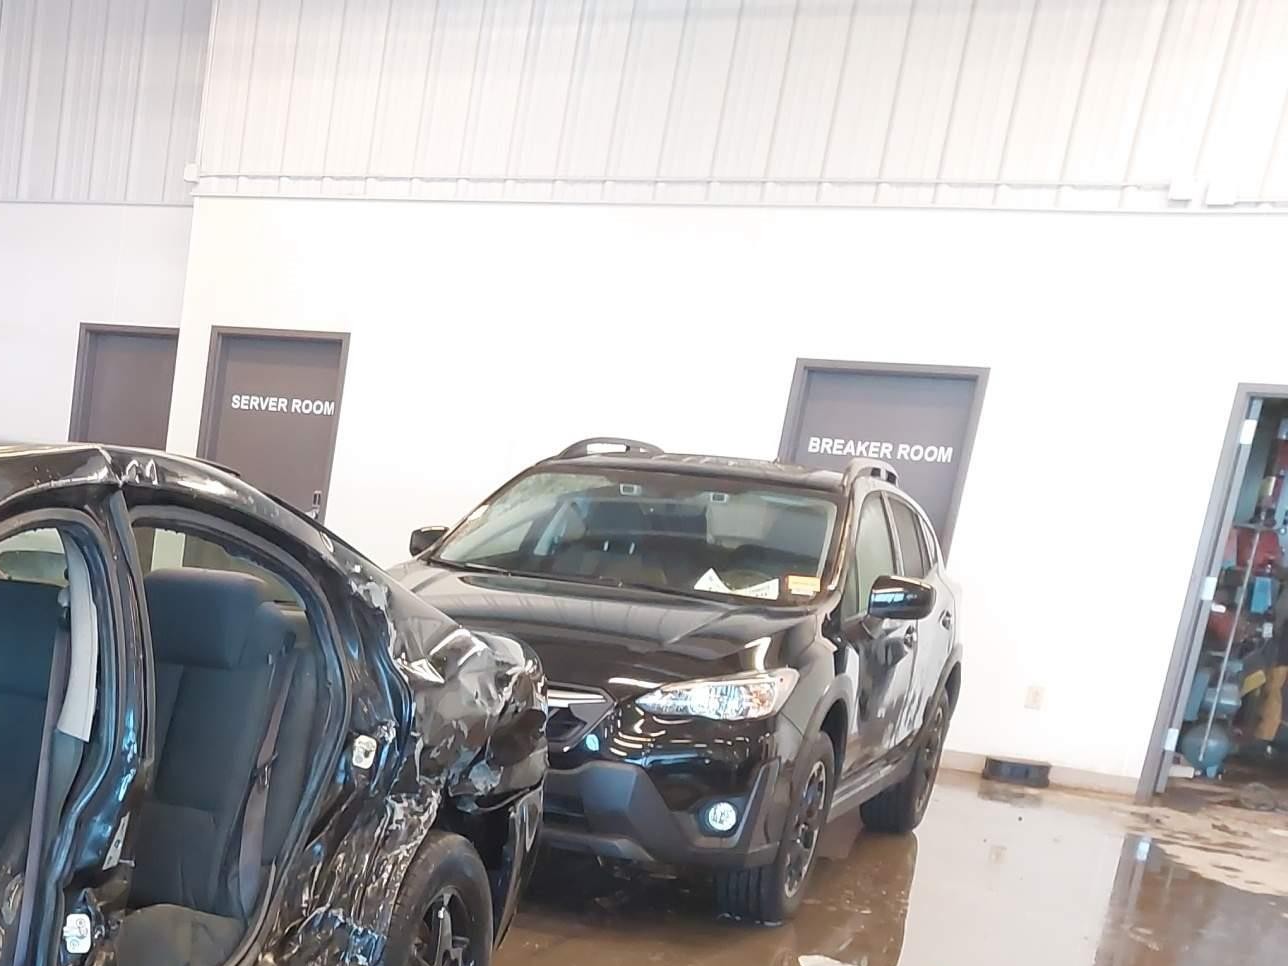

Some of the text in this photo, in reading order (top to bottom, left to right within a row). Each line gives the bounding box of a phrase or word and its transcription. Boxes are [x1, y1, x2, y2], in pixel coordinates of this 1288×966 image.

[231, 394, 335, 416] SERVER ROOM
[808, 436, 953, 463] BREAKER ROOM
